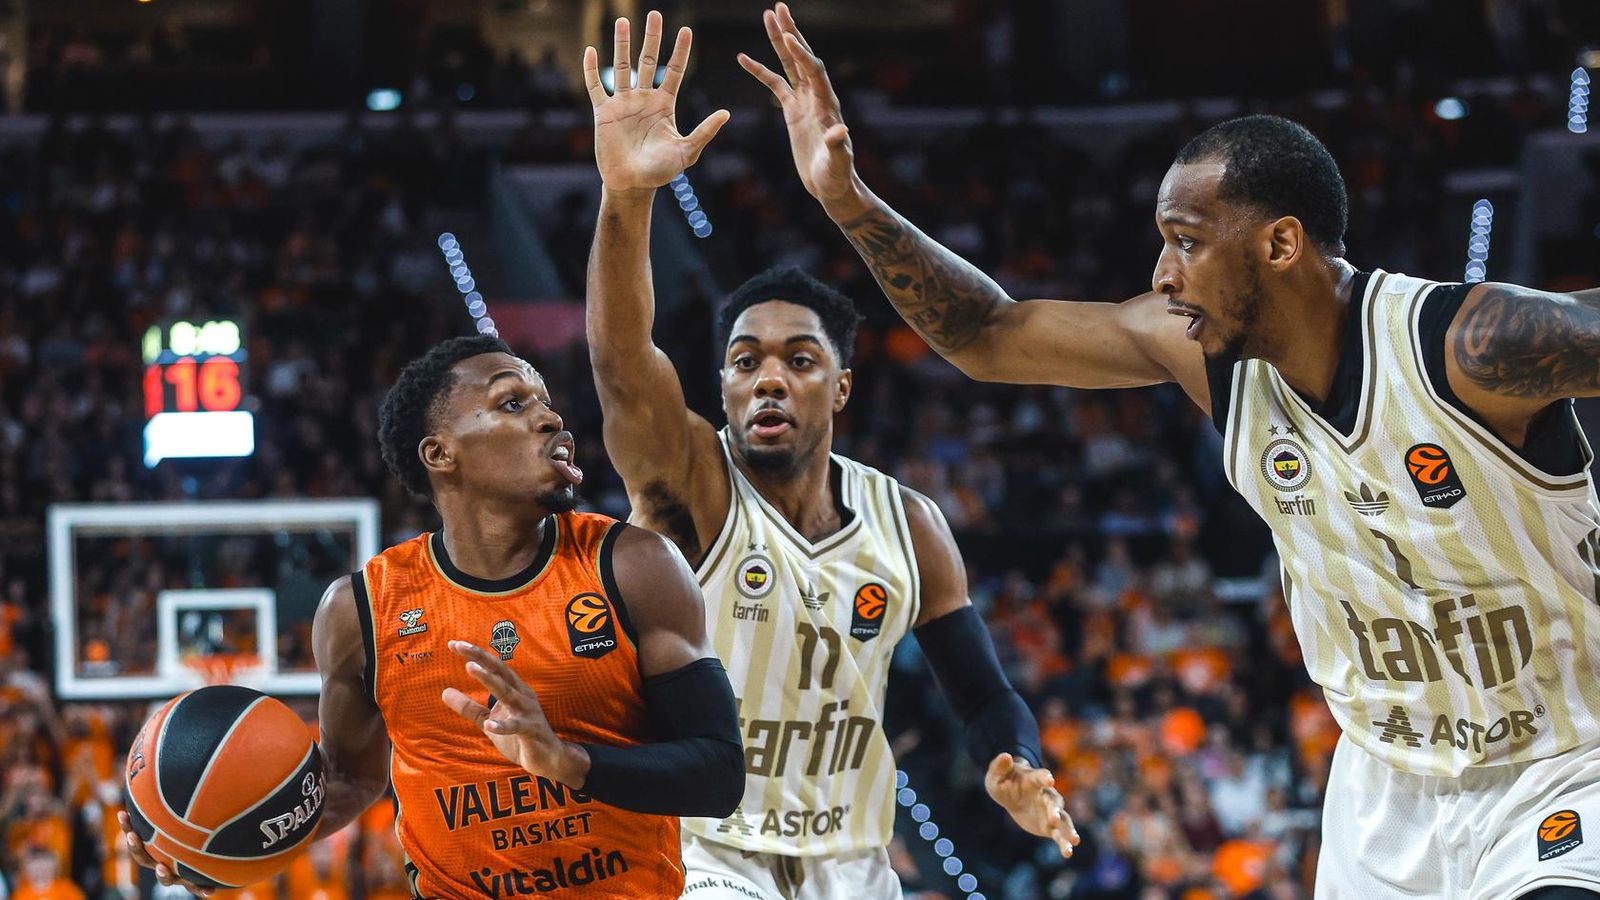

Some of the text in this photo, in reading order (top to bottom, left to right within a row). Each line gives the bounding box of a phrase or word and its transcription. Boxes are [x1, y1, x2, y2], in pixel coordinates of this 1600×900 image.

[165, 357, 241, 412] 16
[1274, 495, 1316, 516] tarfin
[1423, 488, 1462, 505] ETIHAD
[732, 602, 769, 623] tarfin
[400, 625, 427, 637] hummel
[1340, 593, 1533, 690] tarfin
[574, 639, 615, 653] ETIHAD
[796, 621, 841, 690] 11
[490, 812, 593, 851] BASKET
[1541, 840, 1580, 859] ETIHAD
[685, 877, 719, 894] mak
